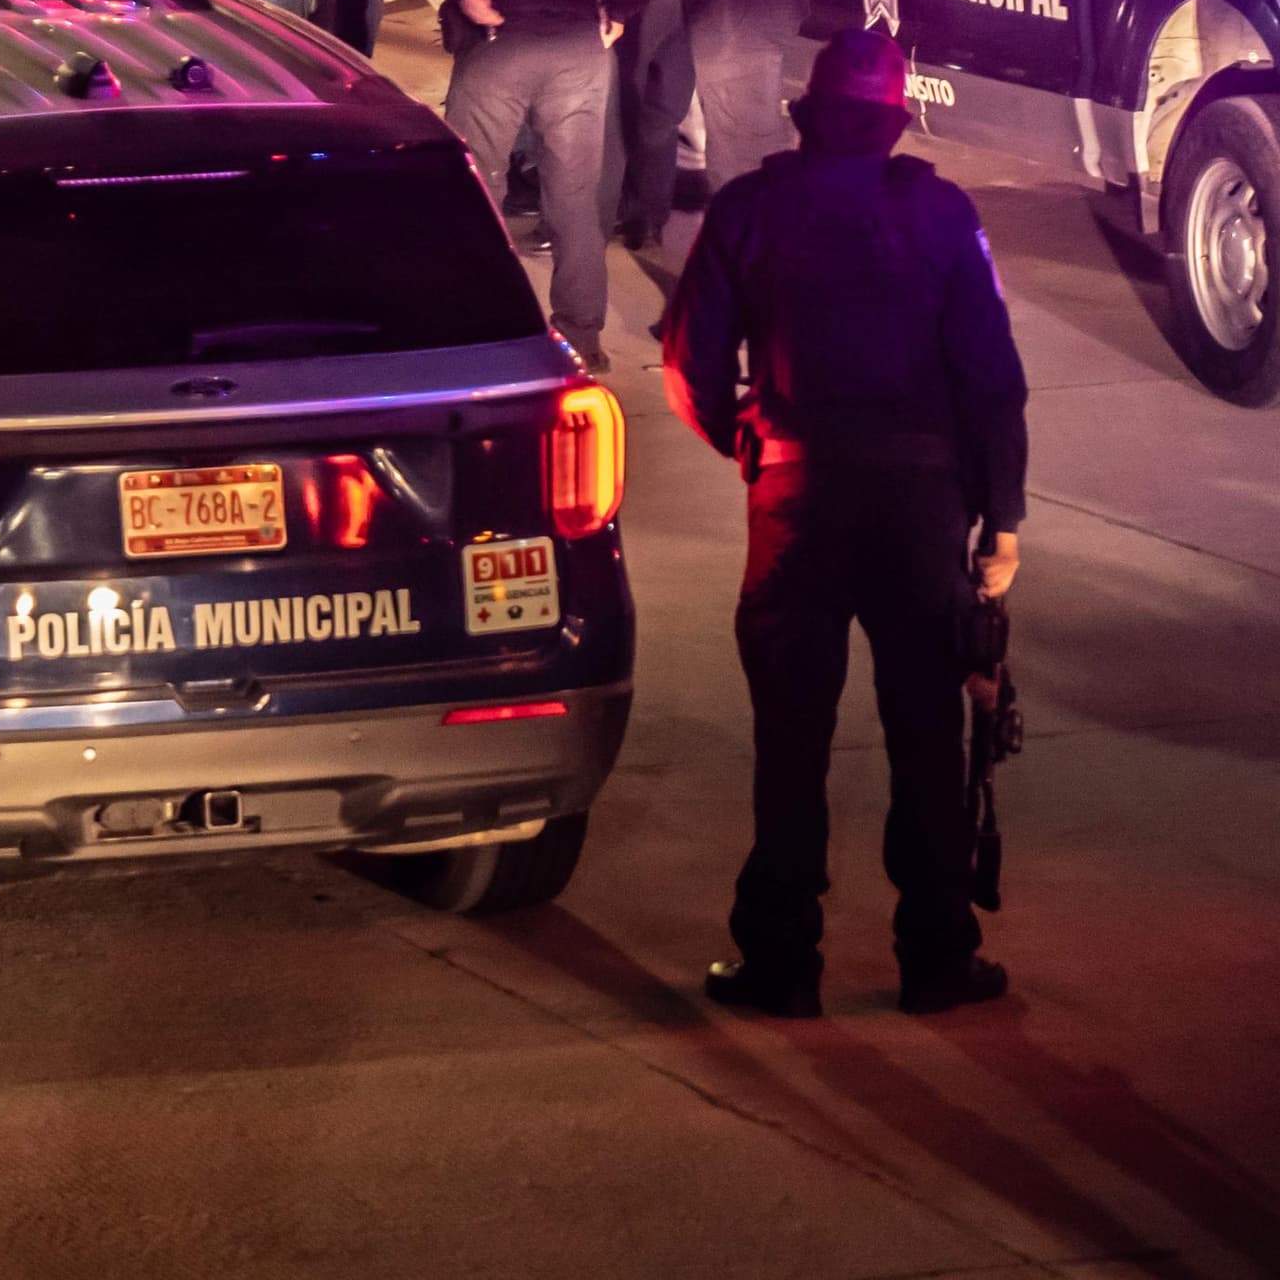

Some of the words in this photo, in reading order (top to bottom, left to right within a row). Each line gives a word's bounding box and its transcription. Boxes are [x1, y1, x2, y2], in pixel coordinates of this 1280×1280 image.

[129, 489, 277, 530] BC-768A-2
[477, 549, 542, 579] 911
[7, 599, 177, 661] POLICÍA
[194, 588, 421, 651] MUNICIPAL
